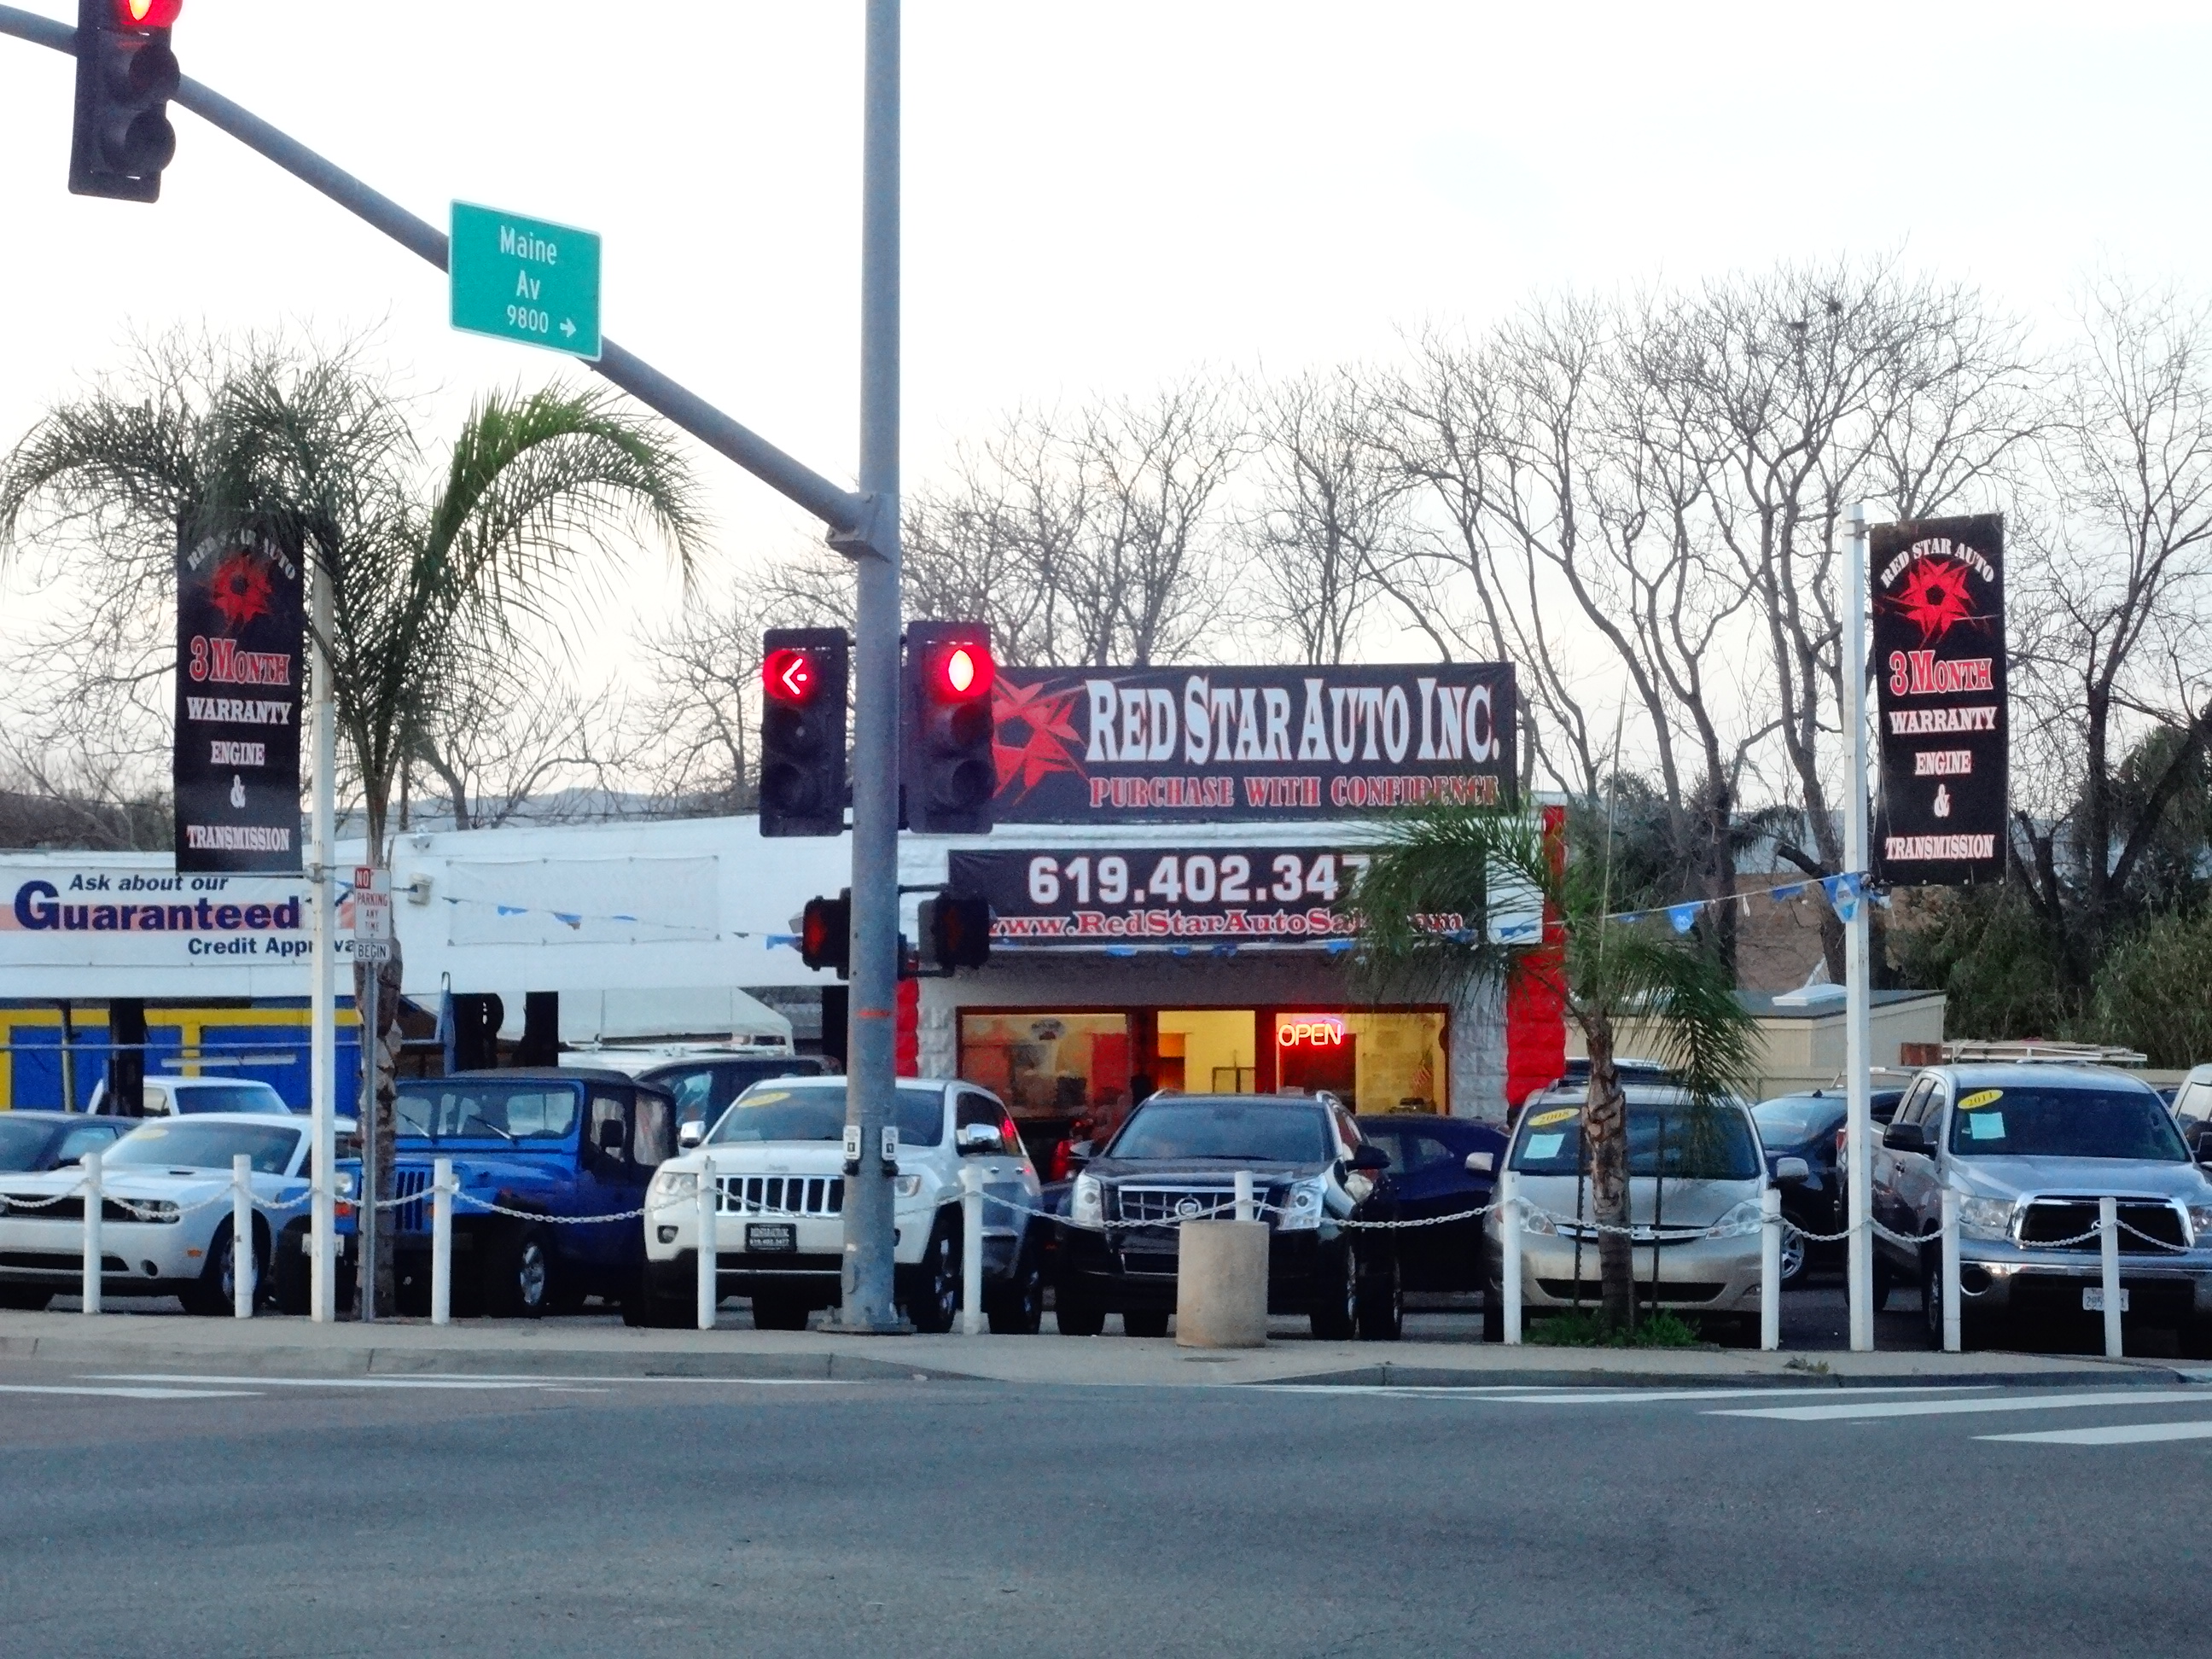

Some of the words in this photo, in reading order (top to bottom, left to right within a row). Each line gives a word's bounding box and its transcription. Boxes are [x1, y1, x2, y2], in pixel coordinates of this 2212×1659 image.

[500, 224, 557, 265] Maine
[515, 270, 540, 300] Av
[507, 305, 549, 333] 9800
[1880, 550, 1910, 589] RED
[1912, 538, 1952, 560] STAR
[1954, 542, 1994, 582] AUTO
[189, 635, 208, 681] 3
[209, 637, 291, 685] MONTH
[1889, 650, 1908, 696] 3
[1908, 649, 1994, 694] MONTH
[186, 696, 292, 725] WARRANTY
[1086, 679, 1178, 761] RED
[1185, 675, 1292, 765] STAR
[1297, 678, 1409, 764] AUTO
[1417, 678, 1500, 764] INC.
[1889, 707, 1997, 735] WARRANTY
[211, 741, 265, 766] ENGINE
[1914, 750, 1971, 776] ENGINE
[230, 774, 246, 808] &
[1090, 777, 1234, 807] PURCHASE
[1244, 776, 1321, 807] WITH
[1330, 776, 1499, 807] CONFIDENCE
[1934, 783, 1950, 818] &
[186, 824, 290, 852] TRANSMISSION
[1886, 834, 1995, 861] TRANSMISSION
[69, 874, 111, 892] Ask
[118, 874, 183, 892] about
[190, 877, 229, 892] our
[356, 870, 370, 888] NO
[1028, 854, 1394, 904] 619.402.347
[15, 880, 300, 930] Guaranteed
[357, 893, 387, 906] PARKING
[365, 922, 380, 932] TIME
[366, 910, 379, 919] ANY
[188, 937, 257, 955] Credit
[358, 944, 387, 958] BEGIN
[1278, 1023, 1342, 1046] OPEN
